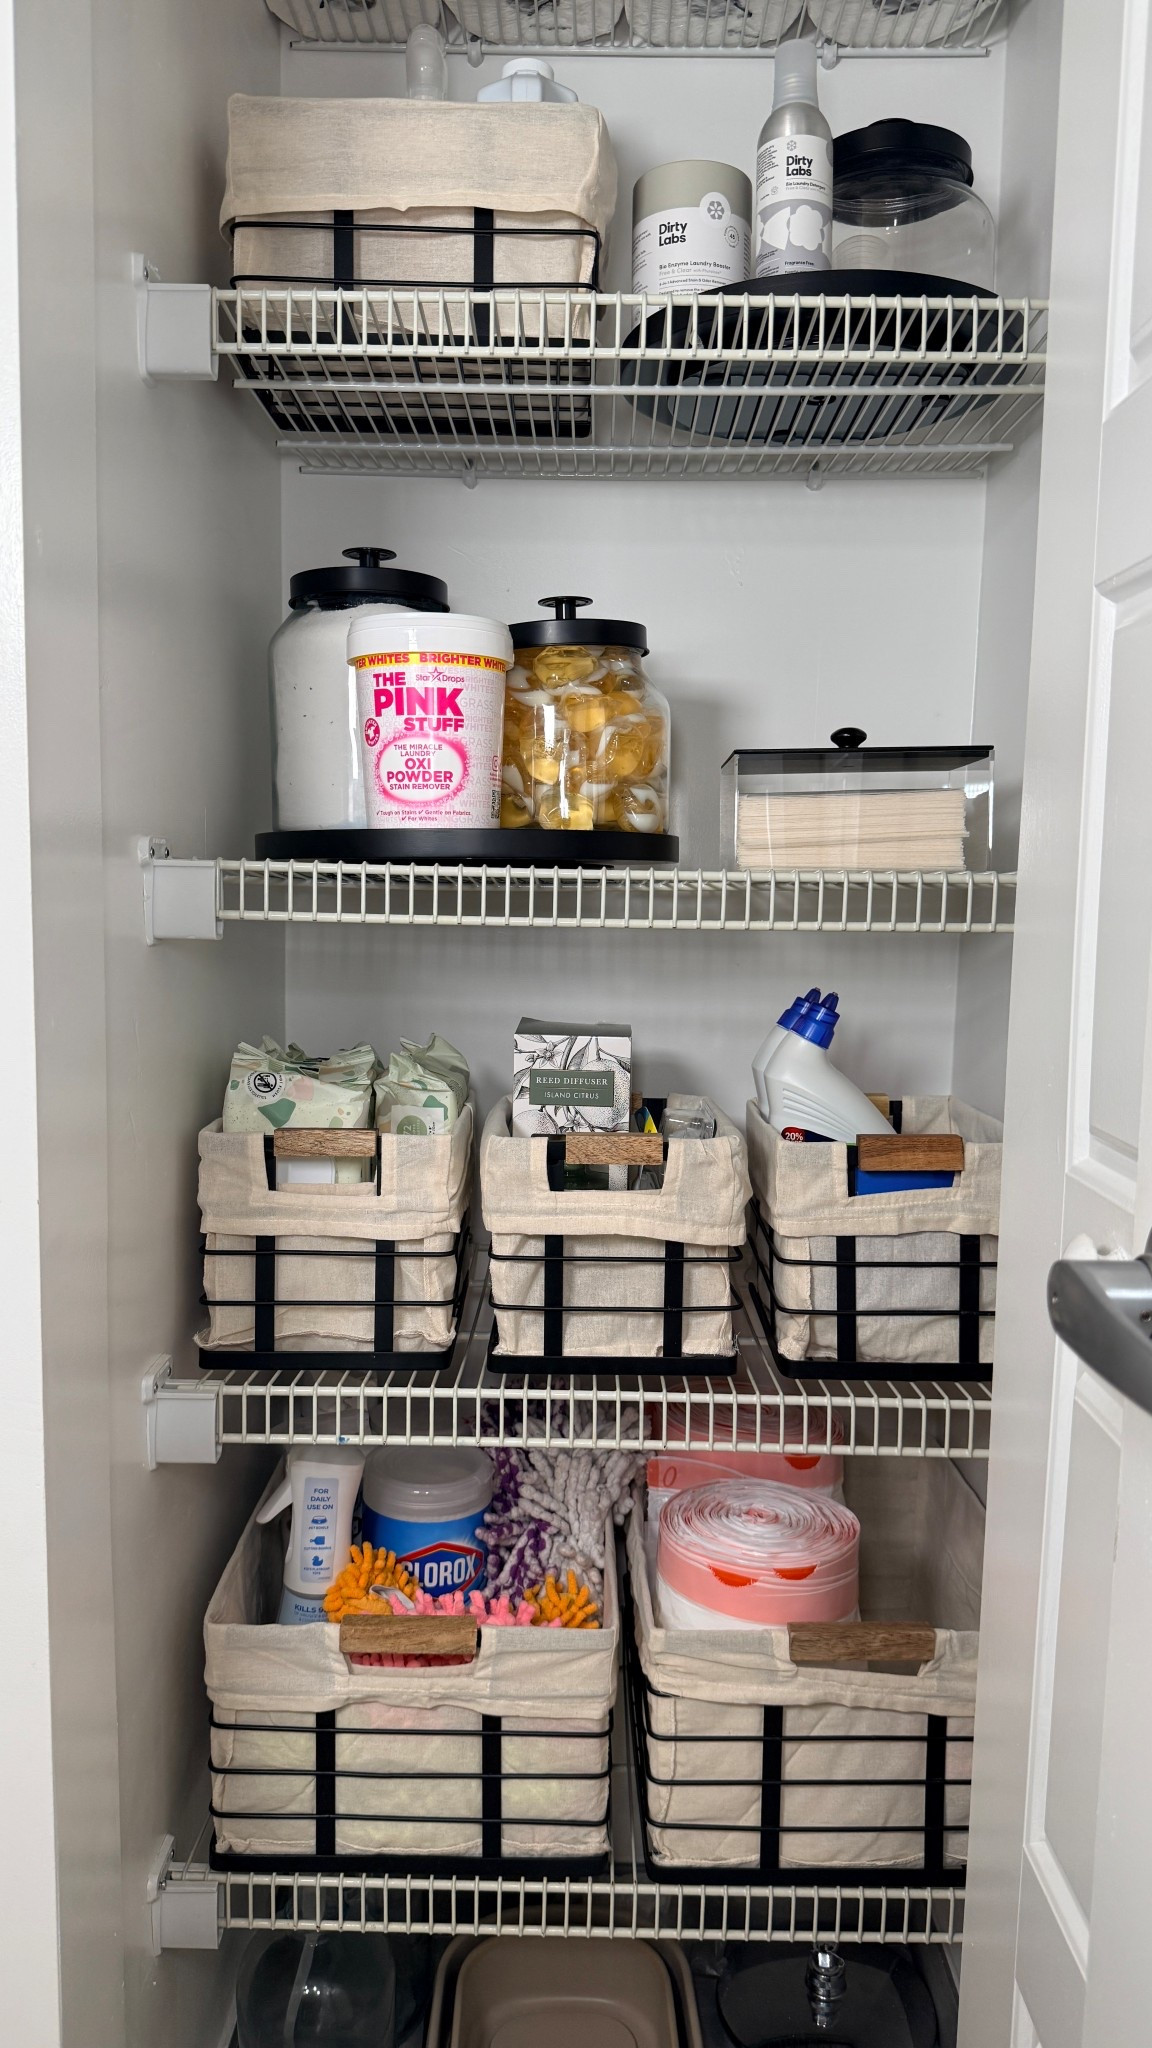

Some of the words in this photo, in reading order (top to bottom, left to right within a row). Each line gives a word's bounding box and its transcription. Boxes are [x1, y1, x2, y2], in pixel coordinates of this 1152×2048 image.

[786, 155, 813, 168] Dirty
[786, 166, 812, 176] Labs
[659, 222, 687, 235] Dirty
[659, 234, 686, 246] Labs
[713, 262, 730, 270] Booster
[368, 654, 410, 666] WHITES
[420, 652, 481, 666] BRIGHTER
[373, 672, 406, 687] THE
[442, 674, 464, 683] Drops
[374, 687, 464, 717] PINK
[404, 717, 464, 732] STUFF
[405, 758, 431, 770] OXI
[387, 771, 453, 783] POWDER
[564, 1078, 608, 1086] DIFFUSER
[785, 1132, 804, 1140] 20%
[294, 1604, 317, 1613] KILLS
